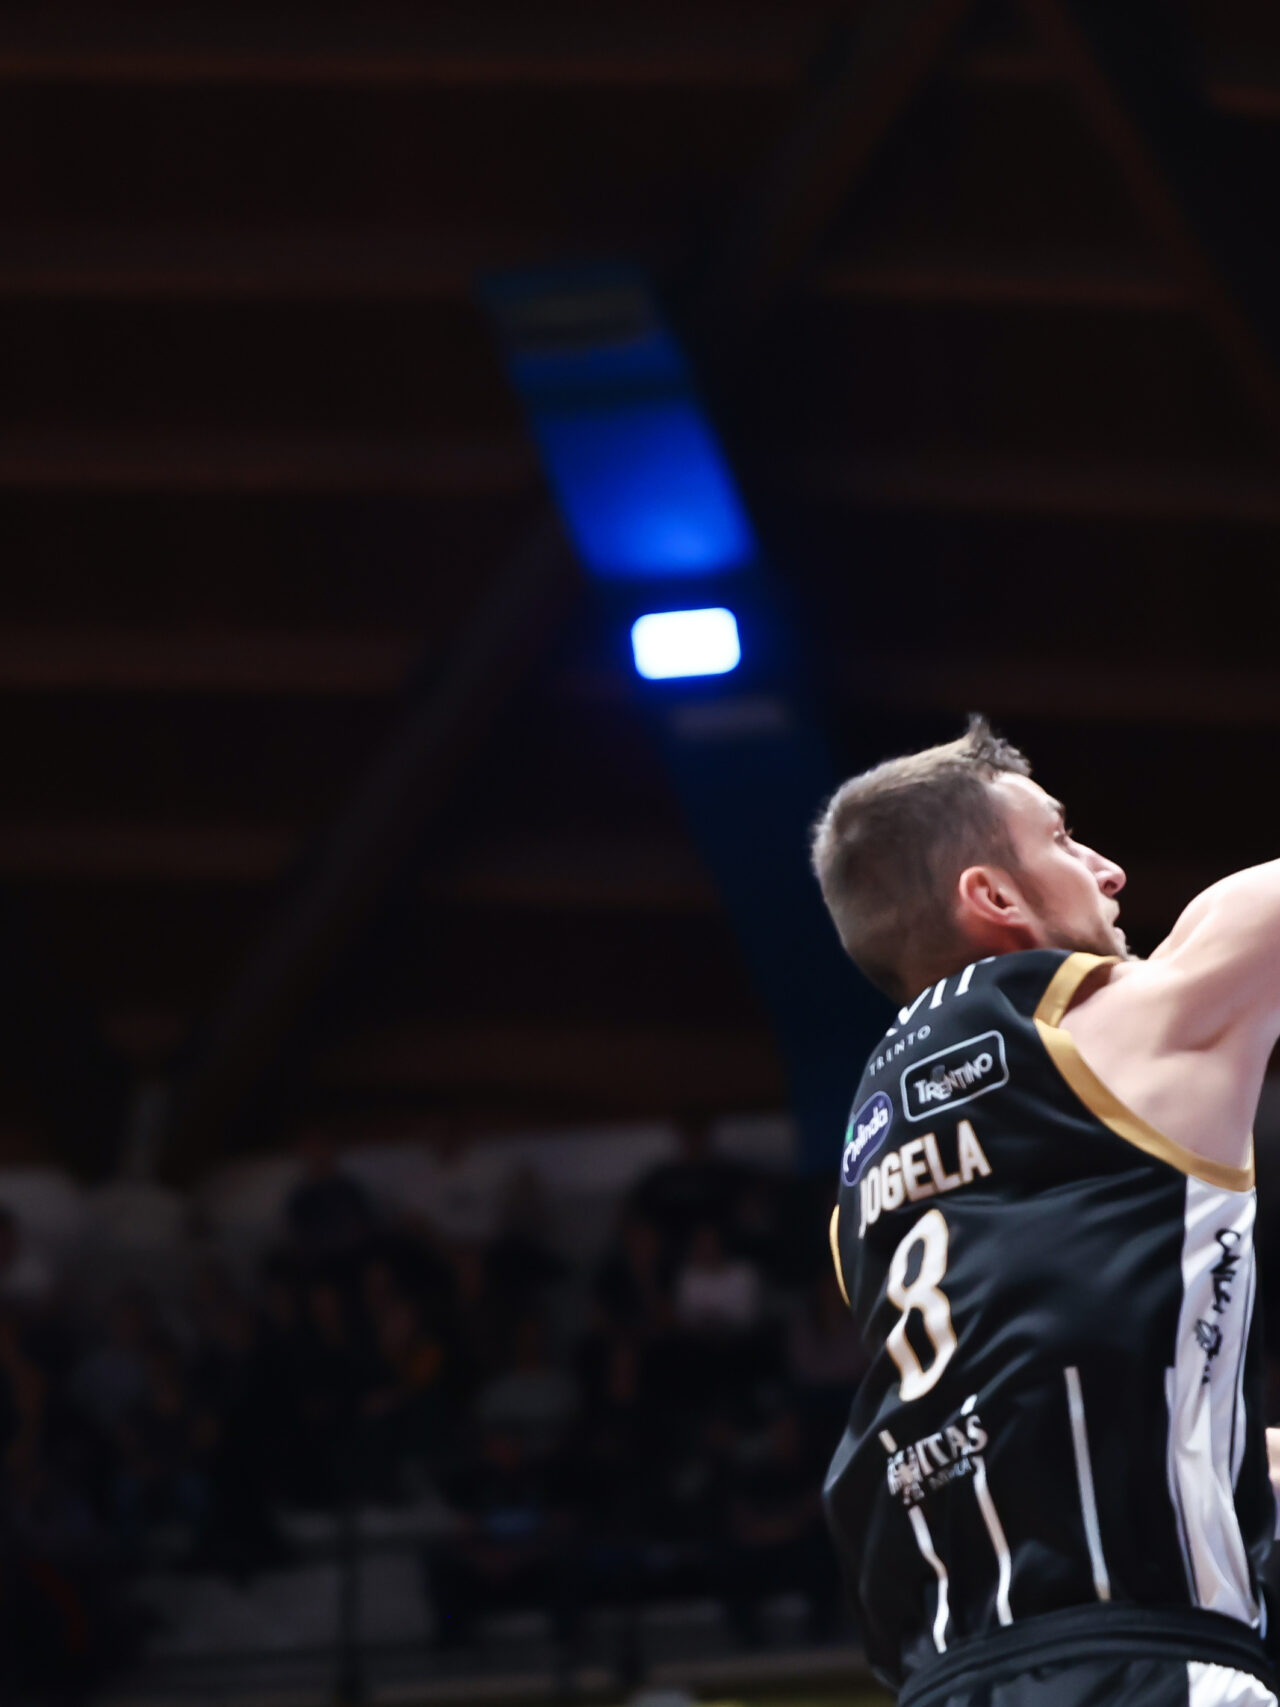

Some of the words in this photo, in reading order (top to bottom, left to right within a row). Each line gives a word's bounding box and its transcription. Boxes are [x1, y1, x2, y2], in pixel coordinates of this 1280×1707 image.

[869, 1023, 932, 1077] TRENTO
[912, 1051, 994, 1104] TRENTINO
[858, 1118, 993, 1239] JOGELA
[886, 1208, 958, 1402] 8
